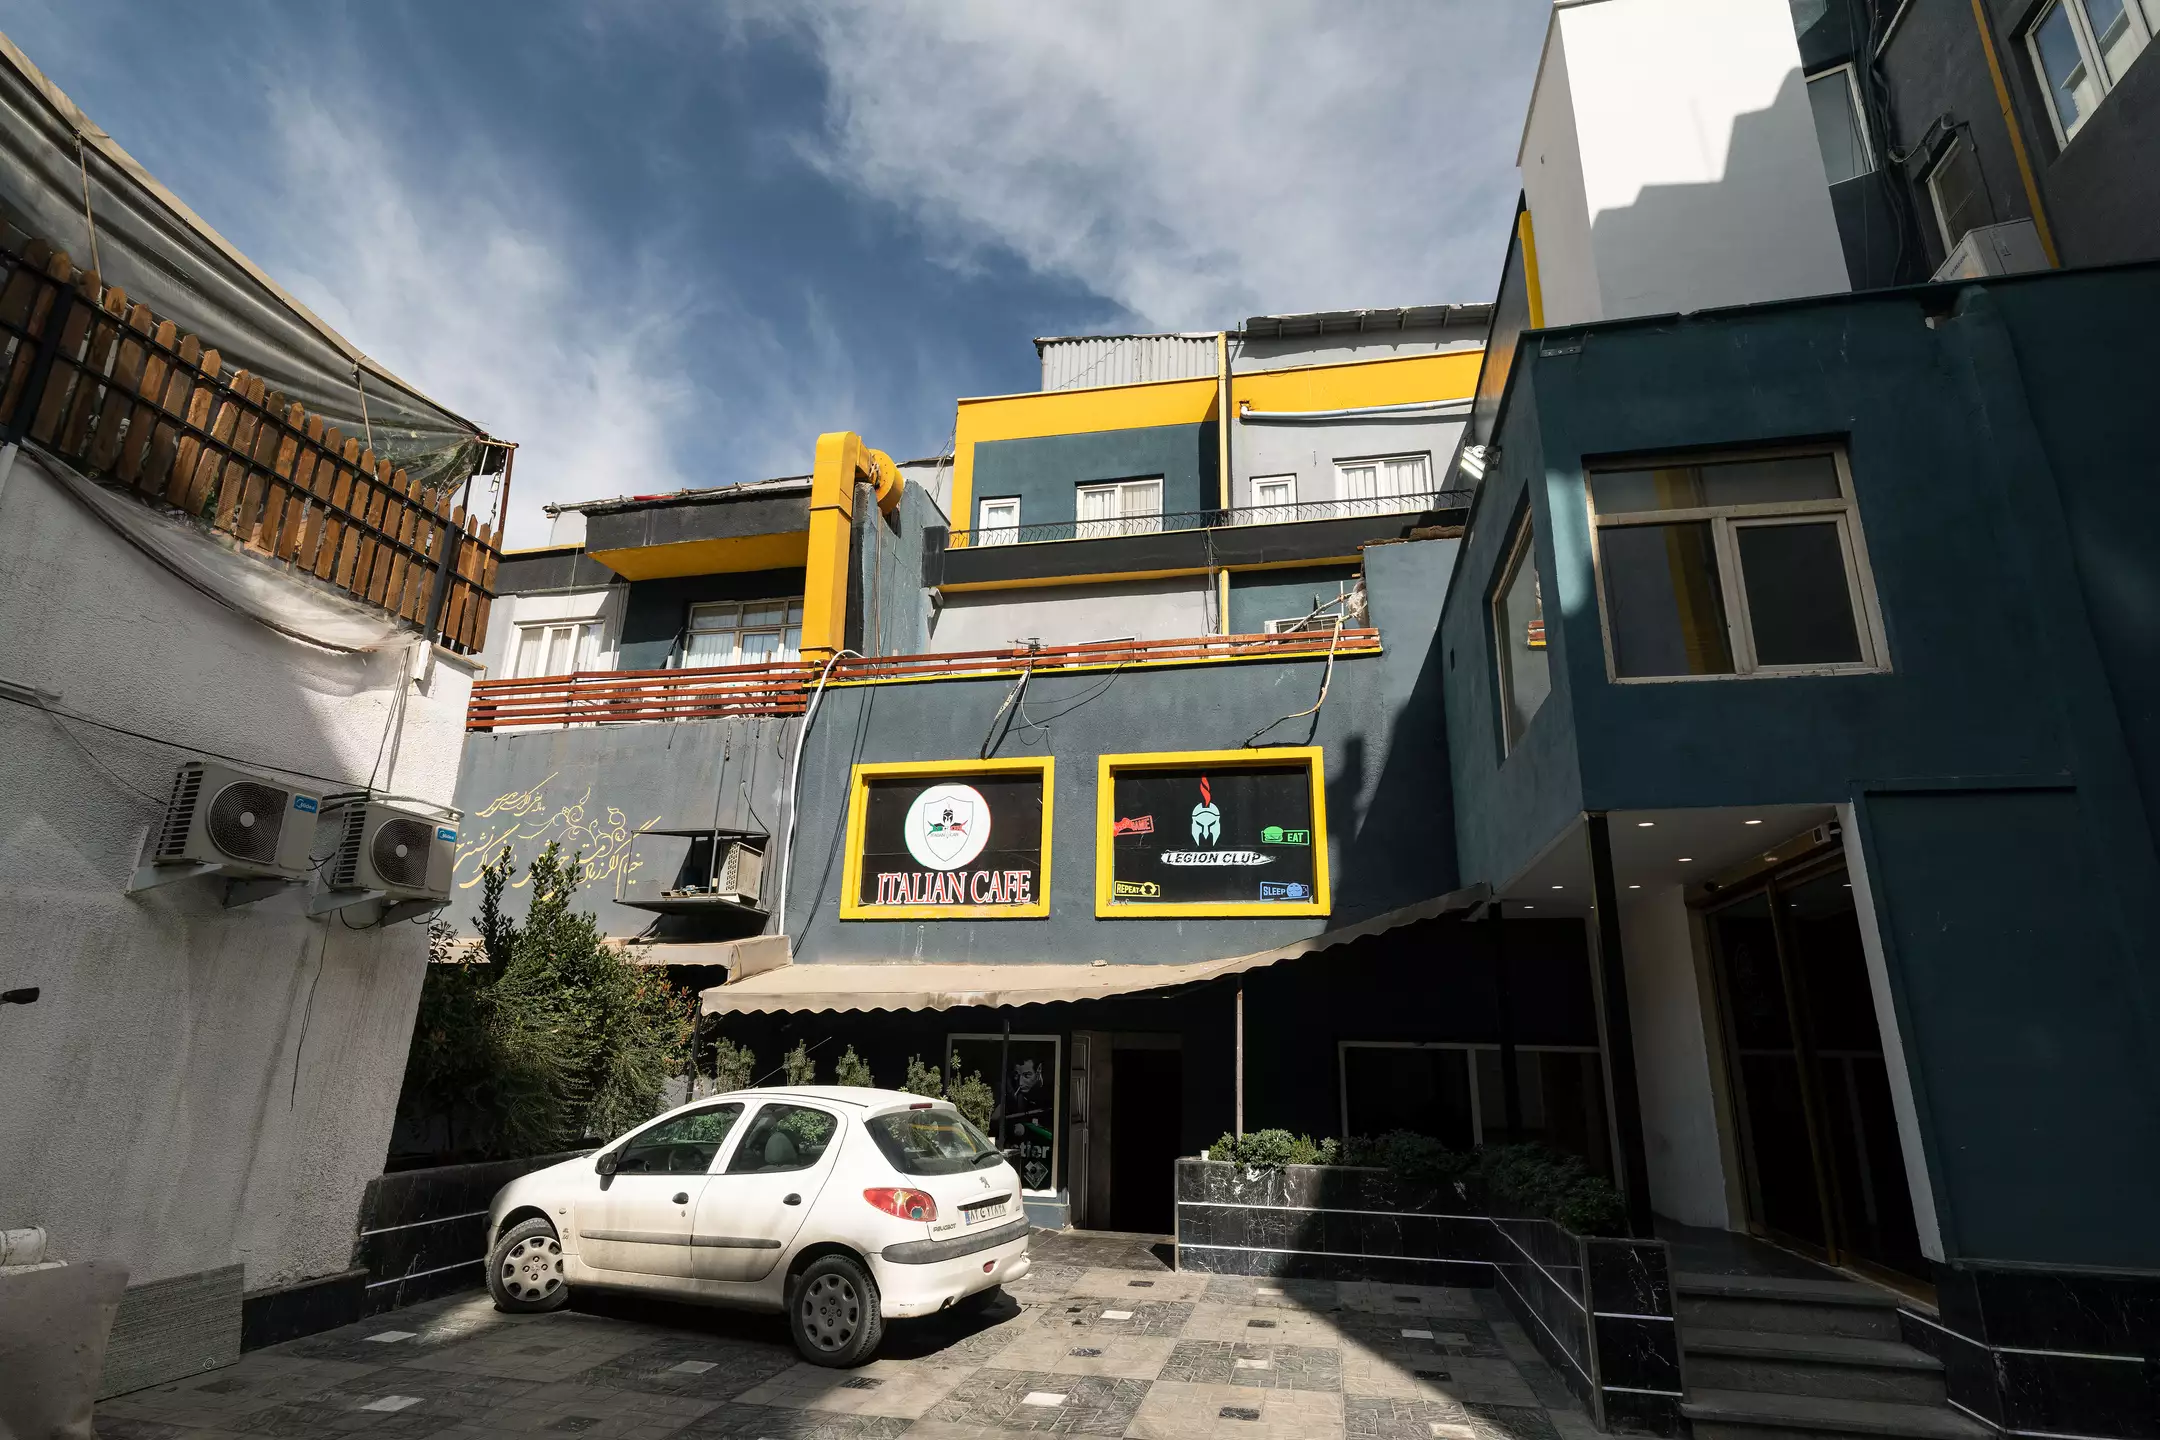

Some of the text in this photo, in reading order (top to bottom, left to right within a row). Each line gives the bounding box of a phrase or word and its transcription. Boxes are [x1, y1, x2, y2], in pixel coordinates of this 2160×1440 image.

[1287, 832, 1304, 843] EAT
[1166, 852, 1261, 864] LEGION CLUP
[876, 870, 1032, 905] ITALIAN CAFE
[1116, 883, 1140, 894] REPEAT
[1263, 886, 1286, 896] SLEEP
